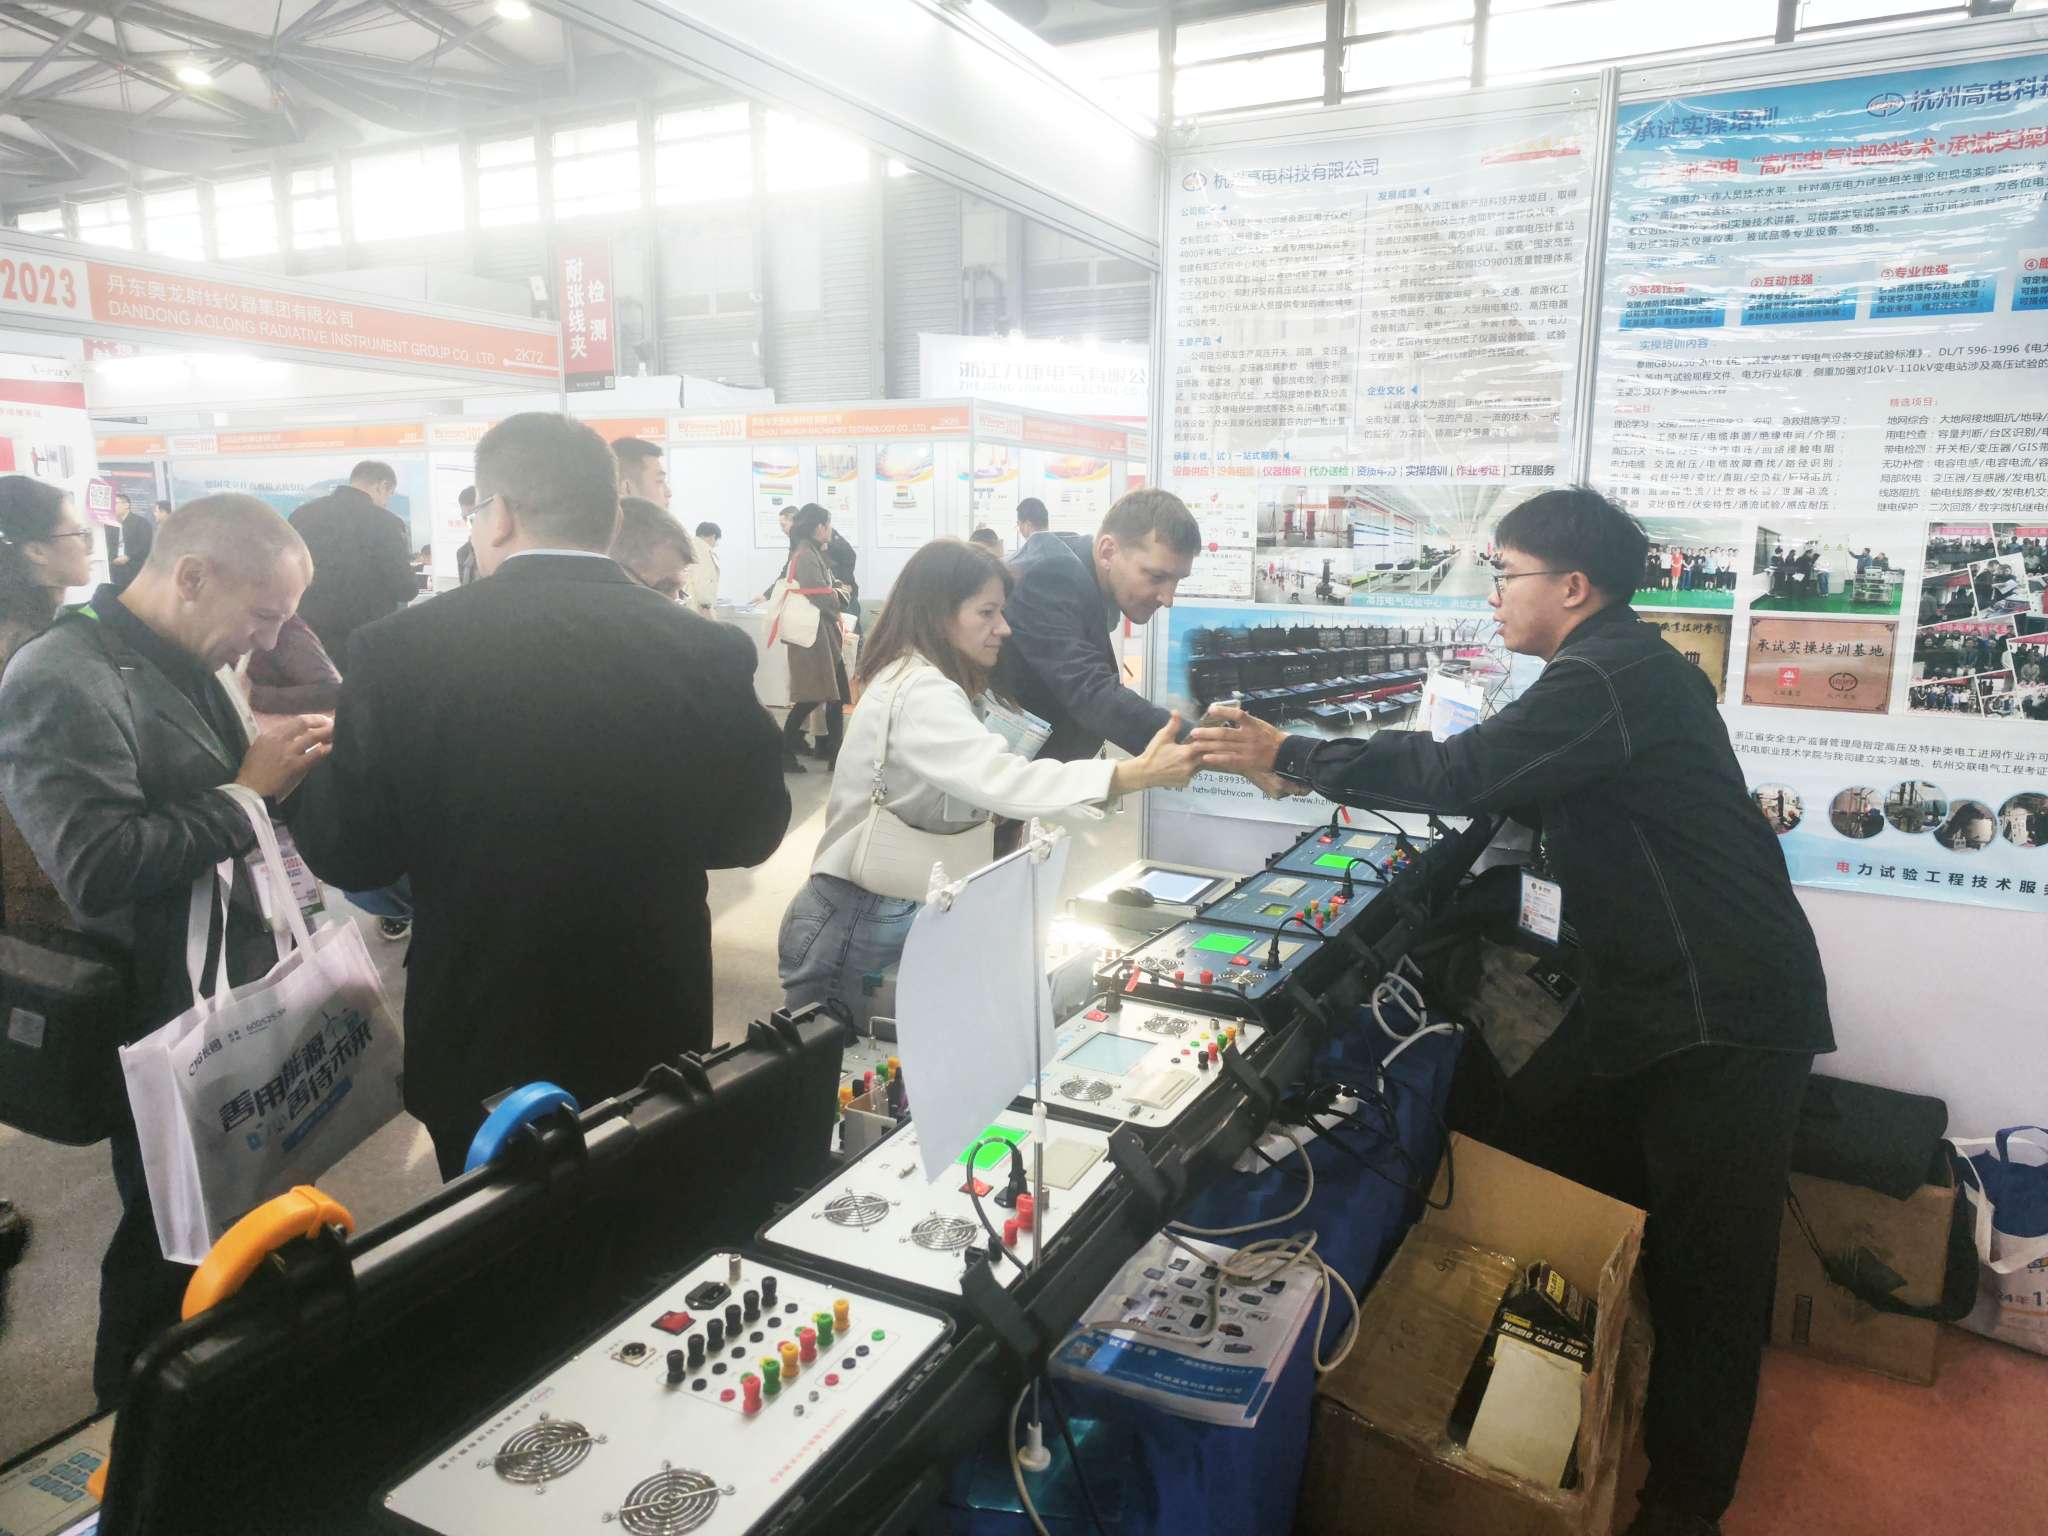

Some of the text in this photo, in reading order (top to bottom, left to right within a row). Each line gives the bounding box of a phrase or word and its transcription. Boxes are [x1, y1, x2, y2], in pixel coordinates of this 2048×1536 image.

[0, 258, 77, 310] 2023
[107, 274, 354, 329] 丹东奥龙射线仪器集团有限公司
[108, 300, 191, 328] DANDONG
[193, 316, 257, 335] AOLONG
[259, 321, 329, 345] RADIATIVE
[330, 330, 410, 354] INSTRUMENT
[410, 343, 451, 360] GROUP
[564, 257, 588, 360] 耐张线夹
[587, 279, 608, 343] 检测
[514, 347, 545, 364] 2K72
[1405, 465, 1447, 476] 实操培训
[1456, 465, 1500, 475] 作业考证
[1510, 464, 1556, 476] 工程服务
[1757, 638, 1885, 658] 承试实操培训基地
[1836, 860, 2048, 897] 电力试验工程技术服
[1501, 1320, 1532, 1340] Name
[1534, 1333, 1562, 1351] Card
[1563, 1344, 1588, 1359] Box
